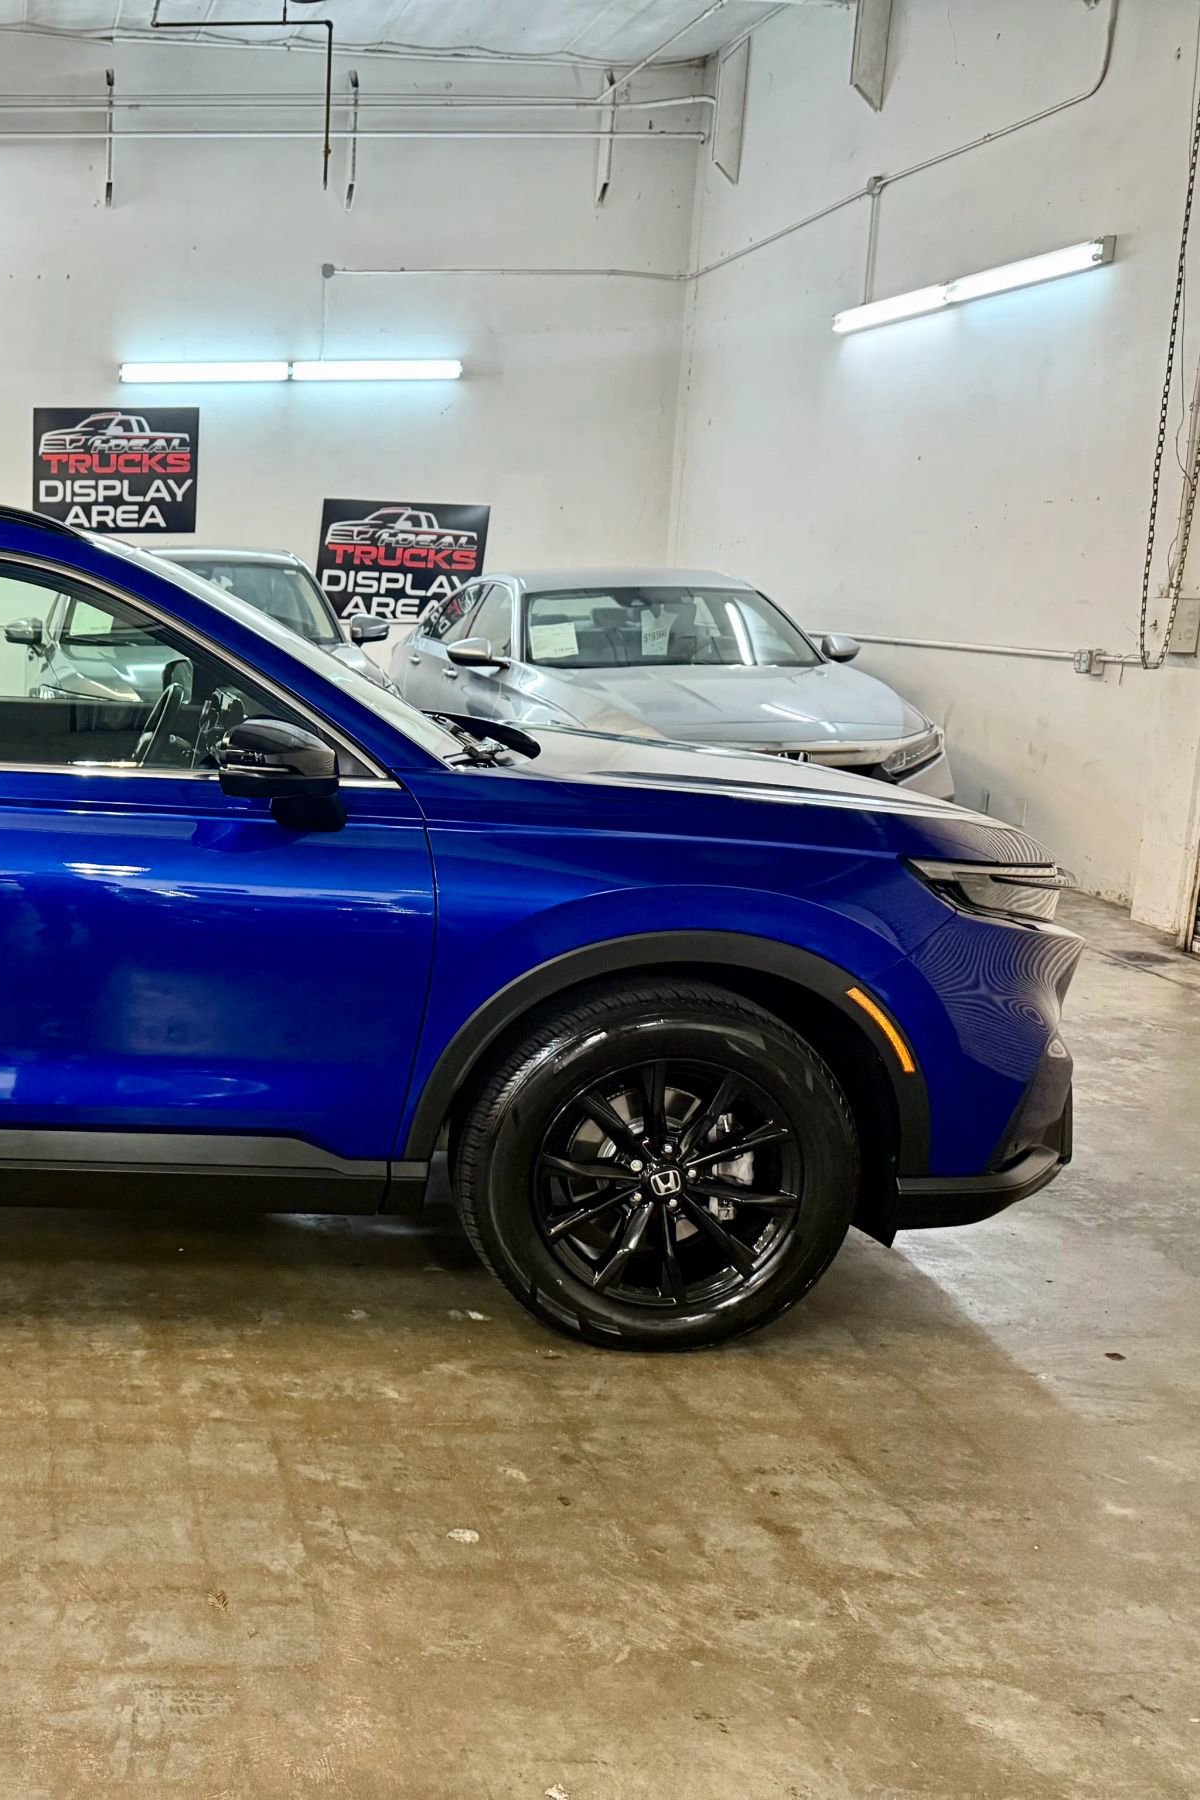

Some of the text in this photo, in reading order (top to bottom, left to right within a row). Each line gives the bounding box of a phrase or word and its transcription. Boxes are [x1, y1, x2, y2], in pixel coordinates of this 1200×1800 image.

[41, 453, 192, 474] TRUCKS
[39, 479, 194, 503] DISPLAY
[65, 504, 167, 528] AREA
[327, 543, 477, 571] TRUCKS
